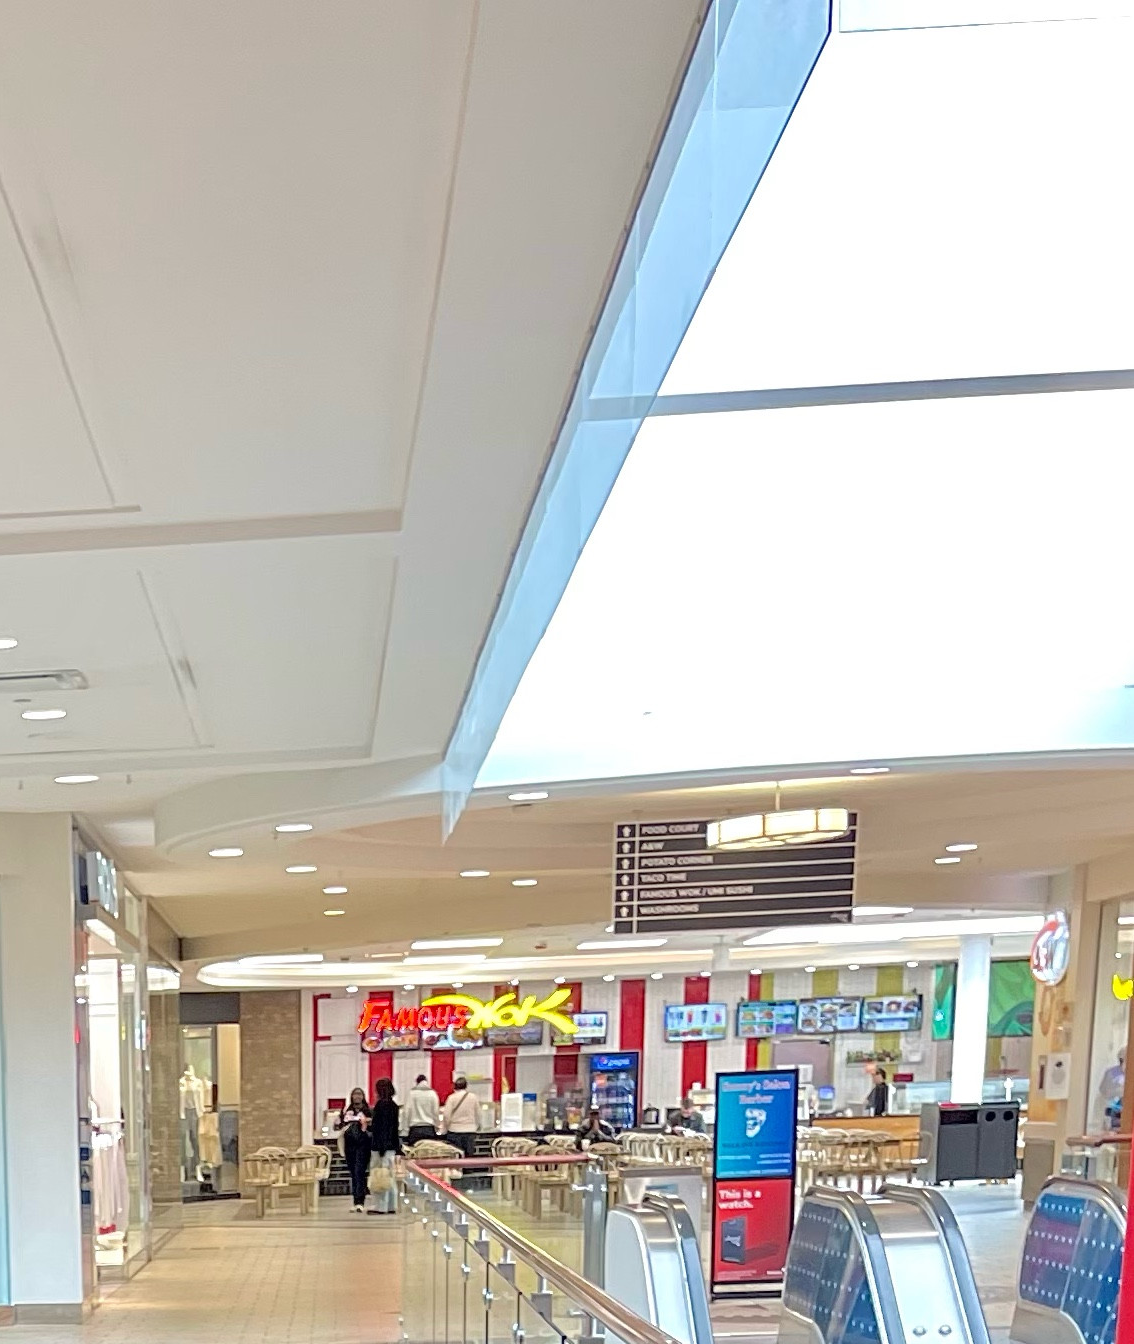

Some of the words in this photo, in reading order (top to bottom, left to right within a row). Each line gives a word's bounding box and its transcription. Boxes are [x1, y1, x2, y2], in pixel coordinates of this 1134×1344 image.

[641, 825, 667, 835] FOOD
[668, 823, 699, 833] COURT
[640, 841, 665, 851] A&W
[640, 857, 676, 867] POTATO
[677, 855, 714, 865] CORNER
[640, 873, 665, 883] TACO
[666, 872, 687, 881] TIME
[640, 888, 677, 899] FAMOUS
[678, 887, 702, 897] WOK
[726, 885, 754, 895] SUSHI
[639, 904, 699, 914] WASHROOMS
[357, 998, 469, 1033] FAMOUS
[718, 1189, 741, 1200] This
[742, 1188, 753, 1199] is
[754, 1190, 762, 1198] a
[718, 1200, 754, 1210] watch.
